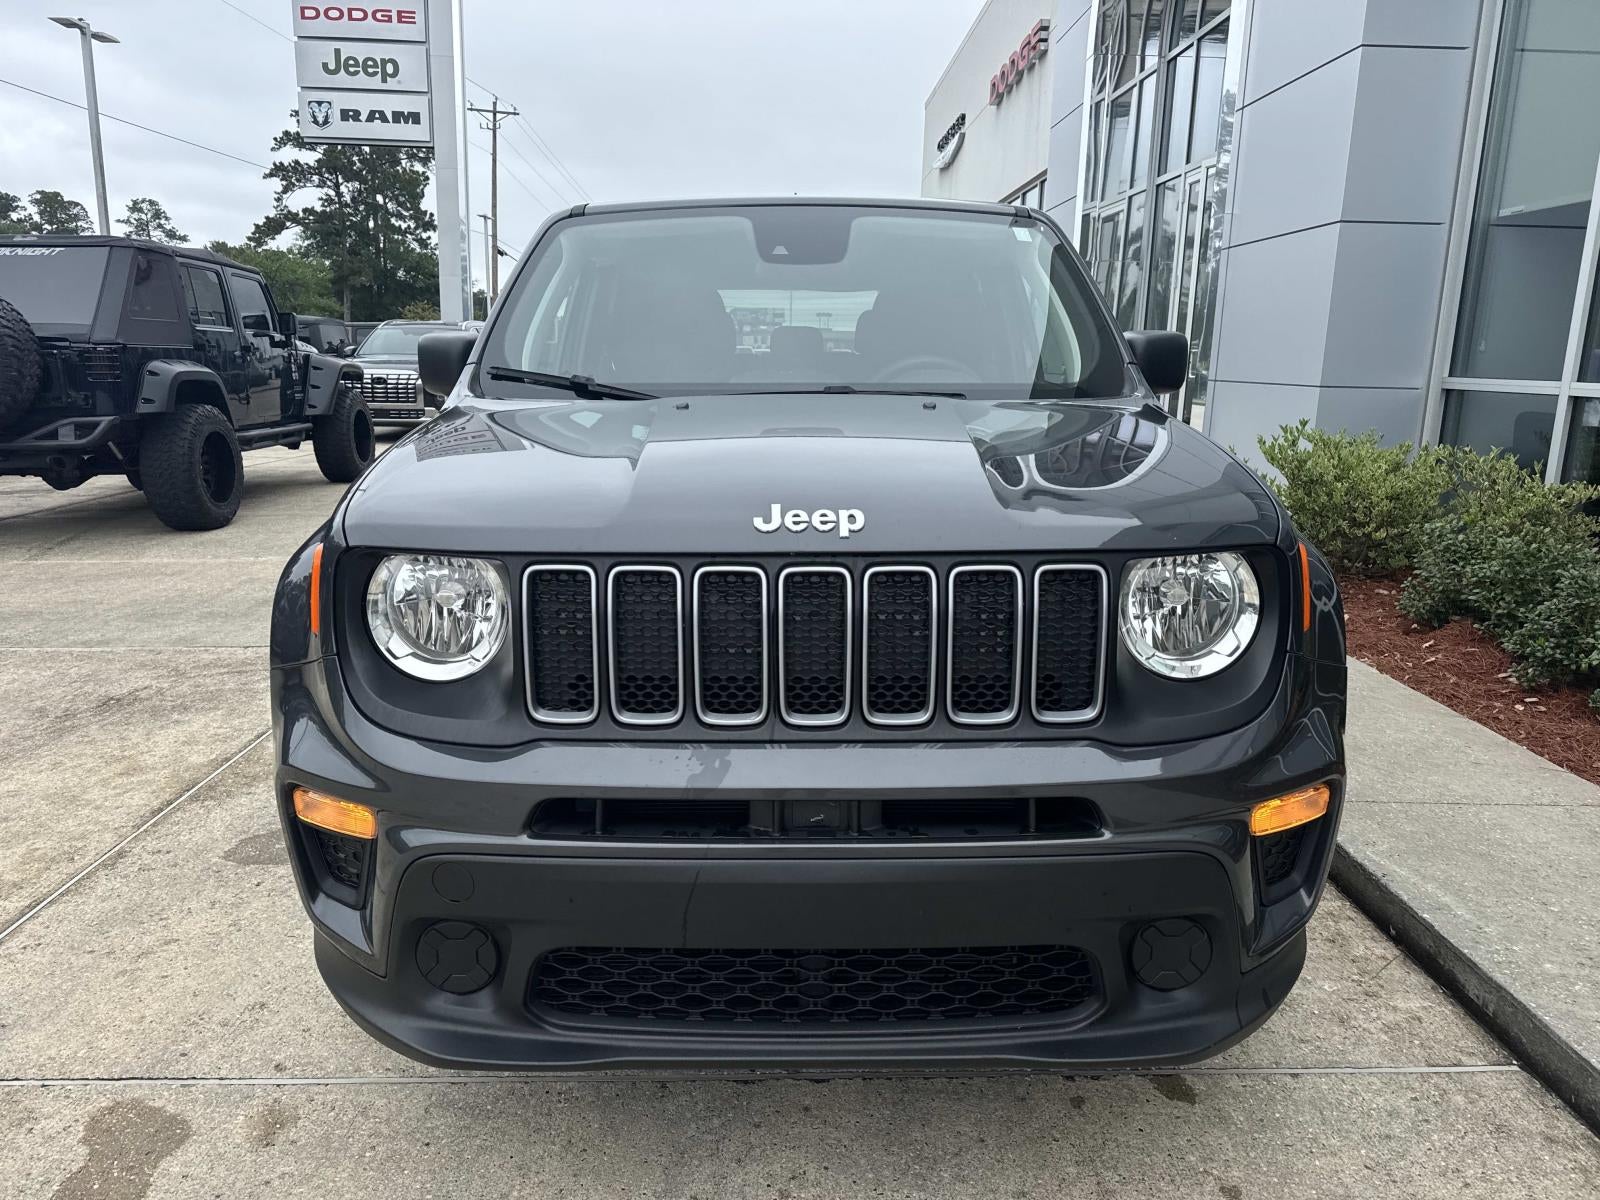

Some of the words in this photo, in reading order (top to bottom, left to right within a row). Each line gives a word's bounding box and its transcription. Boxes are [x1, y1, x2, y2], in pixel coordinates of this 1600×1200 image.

[300, 6, 417, 24] DODGE
[321, 48, 400, 83] Jeep
[989, 19, 1050, 106] DODGE
[340, 109, 421, 125] RAM
[752, 503, 865, 539] Jeep
